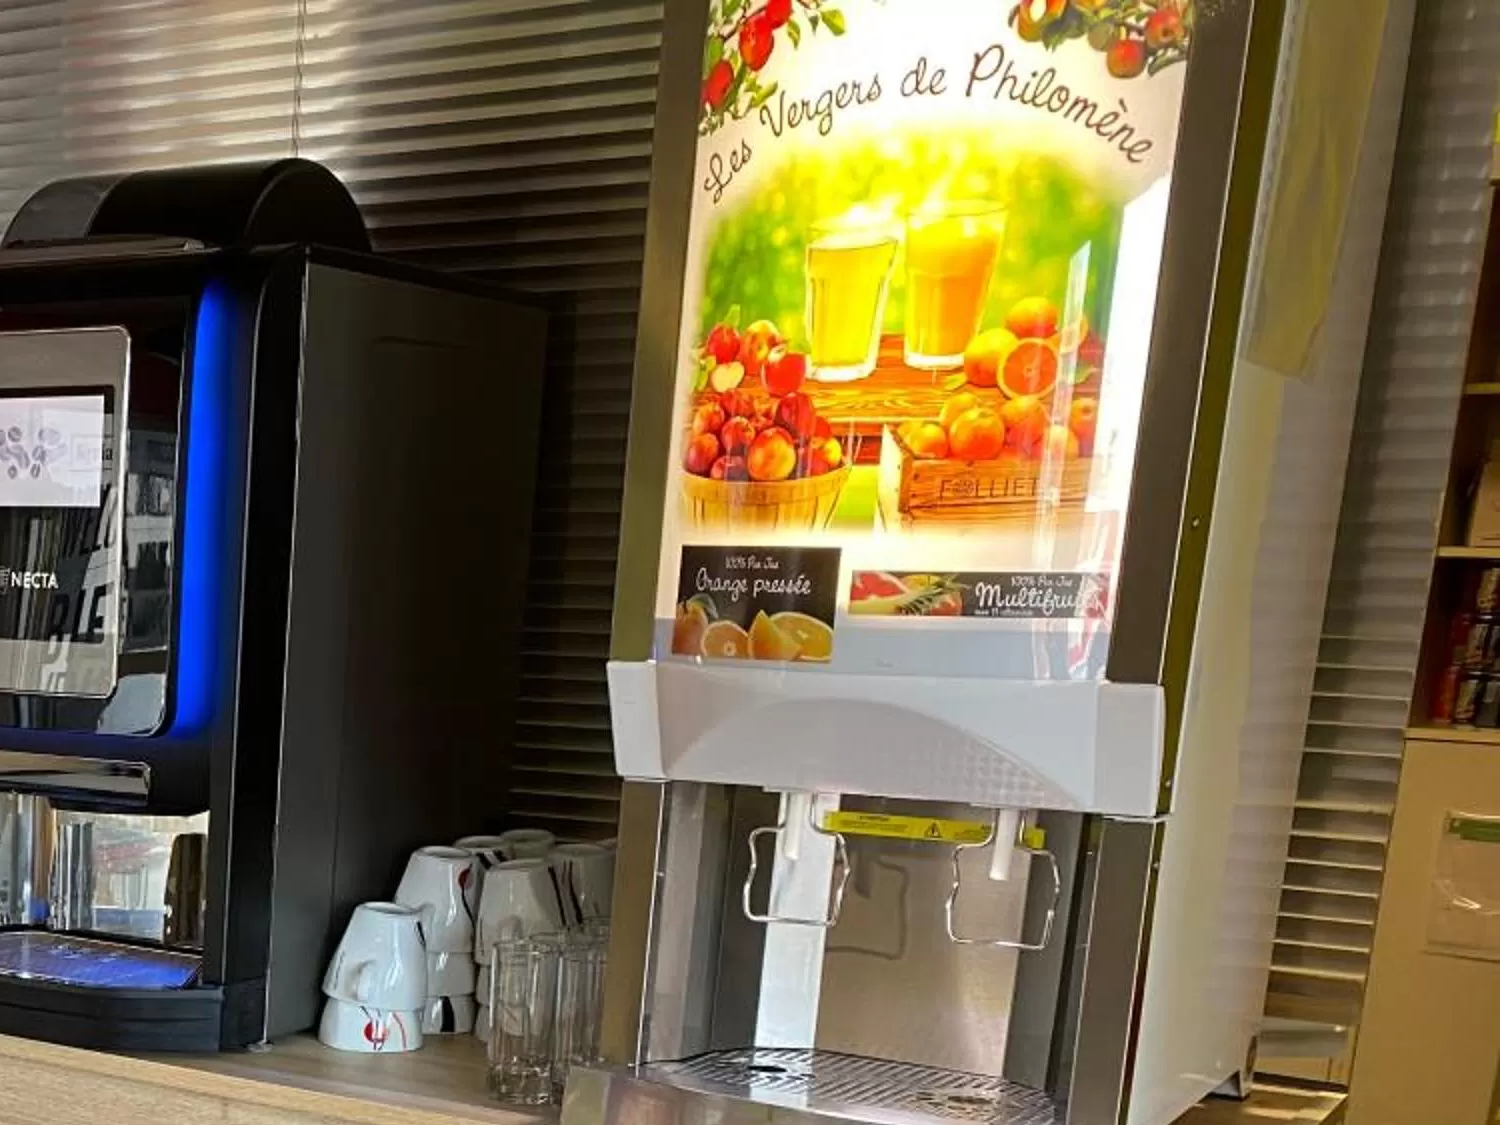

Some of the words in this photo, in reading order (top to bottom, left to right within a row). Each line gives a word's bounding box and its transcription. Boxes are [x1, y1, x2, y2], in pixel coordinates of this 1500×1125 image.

[704, 138, 753, 204] Les
[758, 72, 883, 138] Vergers
[900, 56, 947, 98] de
[964, 43, 1154, 165] Philomène
[10, 570, 60, 590] NECTA
[695, 567, 748, 602] Orange
[753, 575, 812, 598] pressée
